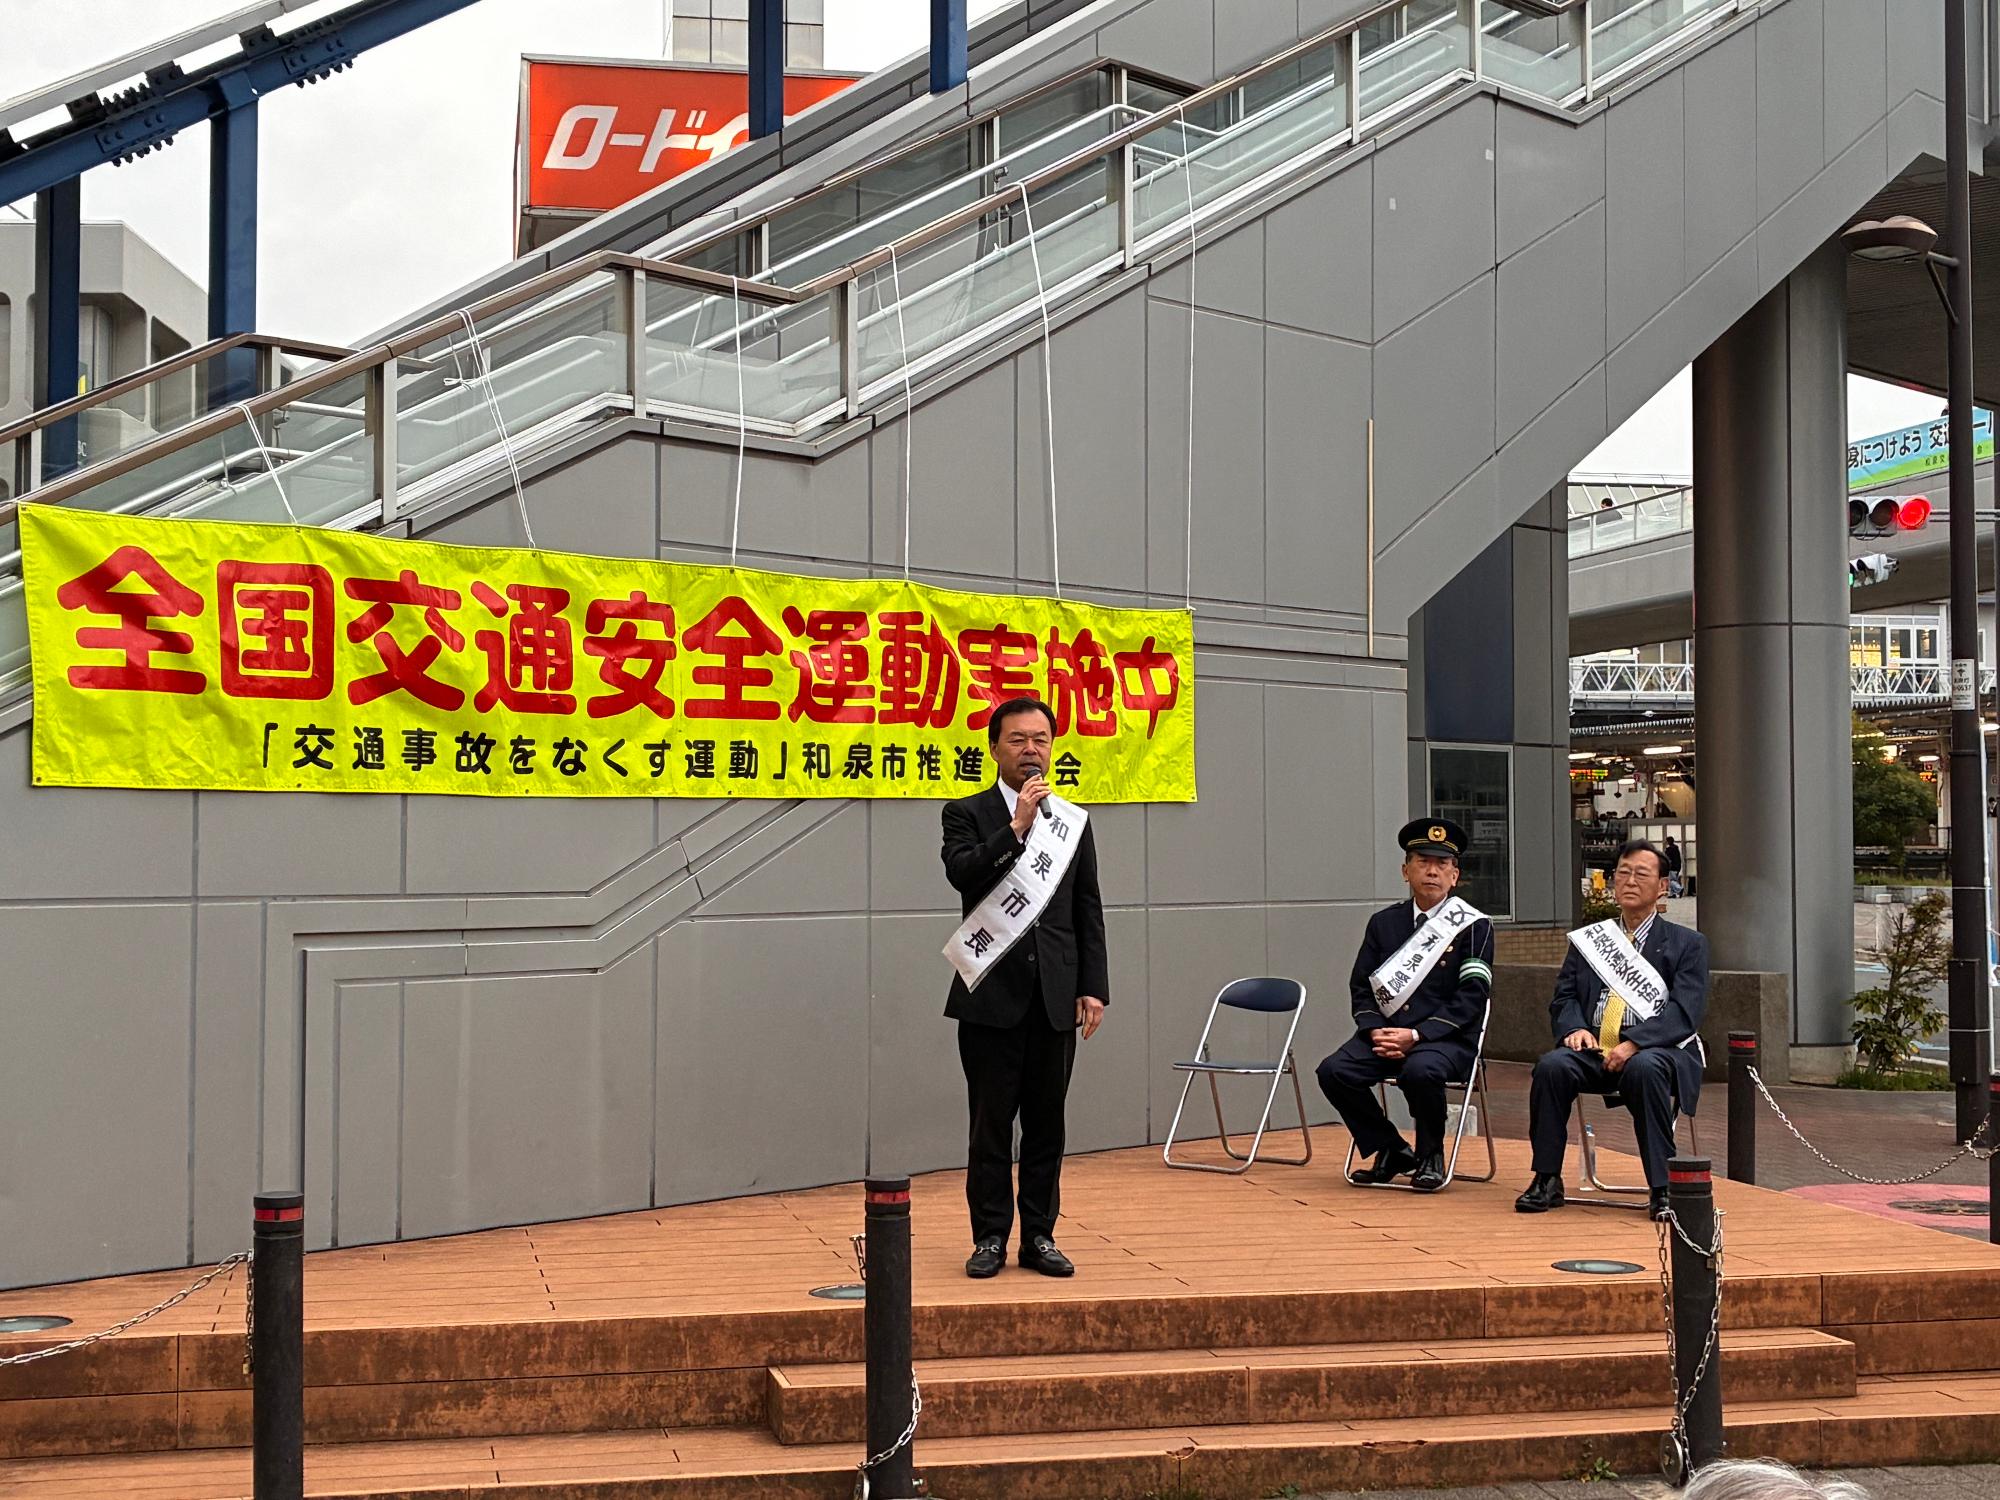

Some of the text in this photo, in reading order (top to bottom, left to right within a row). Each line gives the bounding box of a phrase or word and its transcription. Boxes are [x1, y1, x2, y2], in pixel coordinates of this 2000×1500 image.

[57, 545, 1179, 740] 全国交通安全運動実施中
[964, 815, 1069, 958] 和泉市長
